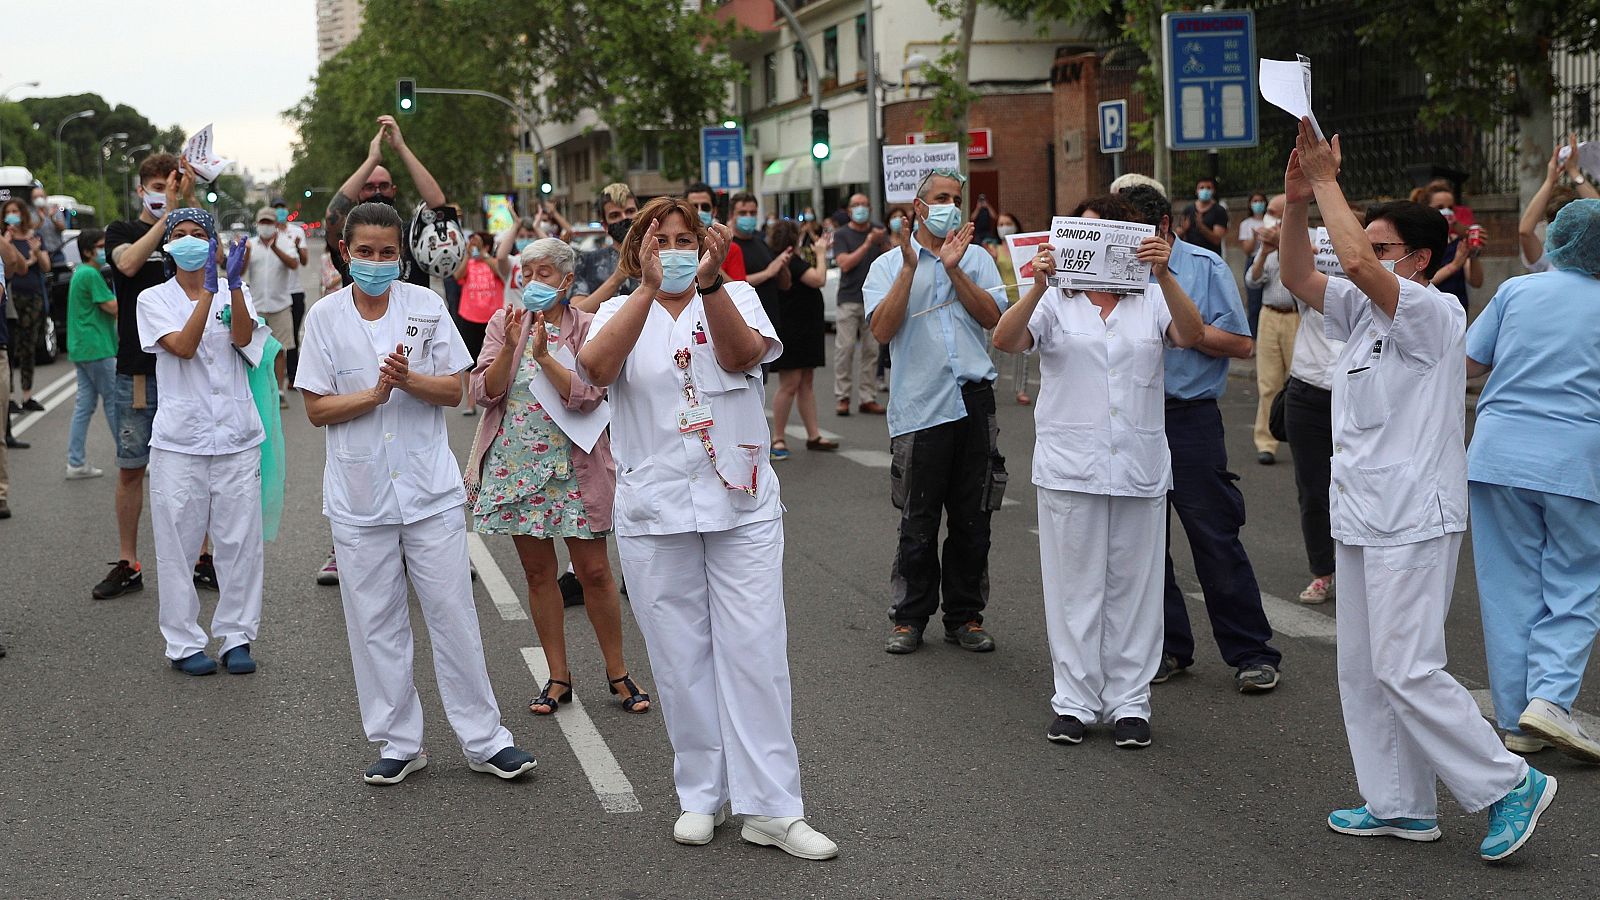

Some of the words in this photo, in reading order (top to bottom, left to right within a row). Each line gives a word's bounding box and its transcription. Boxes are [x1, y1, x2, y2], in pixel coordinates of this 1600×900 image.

[1104, 107, 1119, 146] P
[886, 153, 922, 166] Empleo
[924, 152, 956, 163] basura
[886, 171, 892, 181] y
[893, 169, 917, 179] poco
[888, 182, 917, 192] dañan
[1056, 228, 1101, 242] SANIDAD
[1125, 225, 1153, 233] ESTATALES
[1061, 248, 1075, 259] NO
[1077, 249, 1095, 261] LEY
[1063, 258, 1091, 271] 15/97
